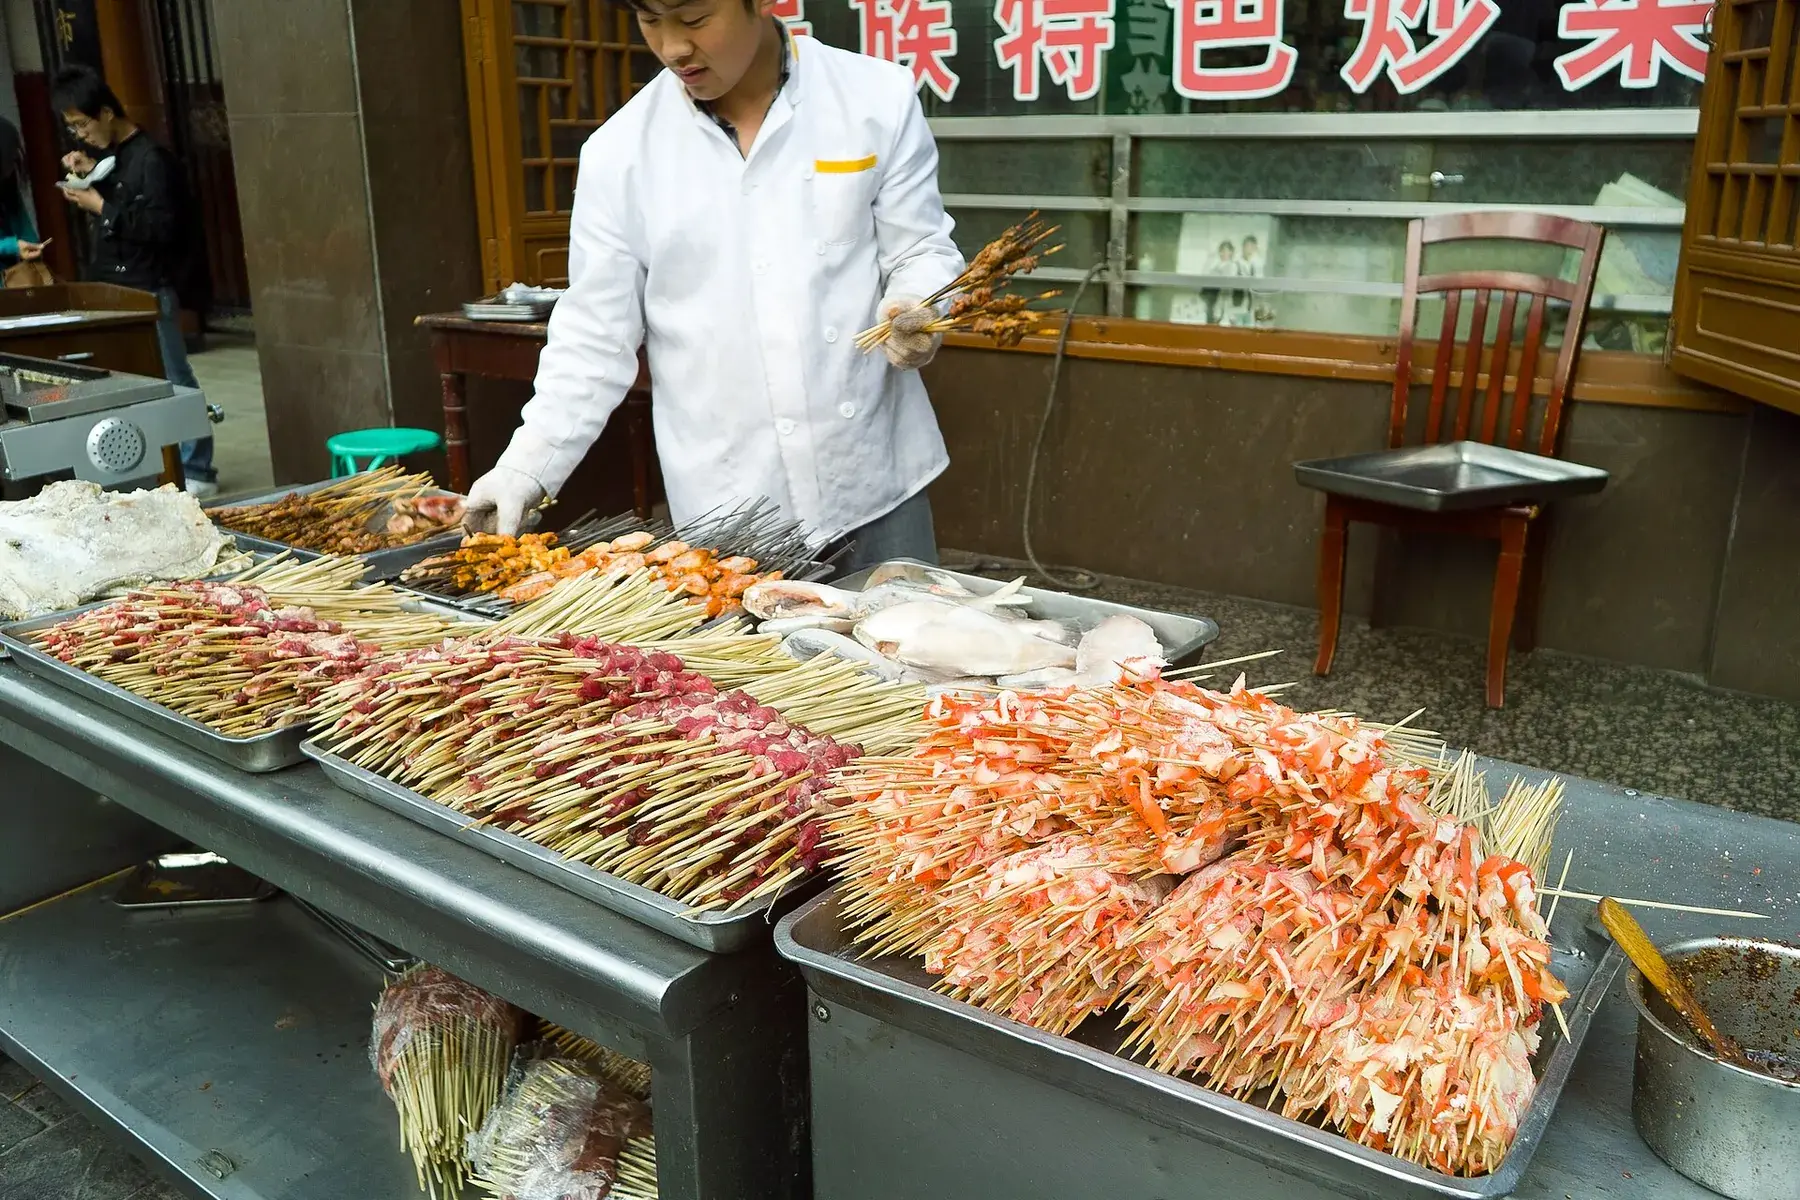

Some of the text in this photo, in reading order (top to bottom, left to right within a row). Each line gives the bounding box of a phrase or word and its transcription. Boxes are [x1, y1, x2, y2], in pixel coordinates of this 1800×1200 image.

[772, 0, 1709, 102] 族特色炒菜
